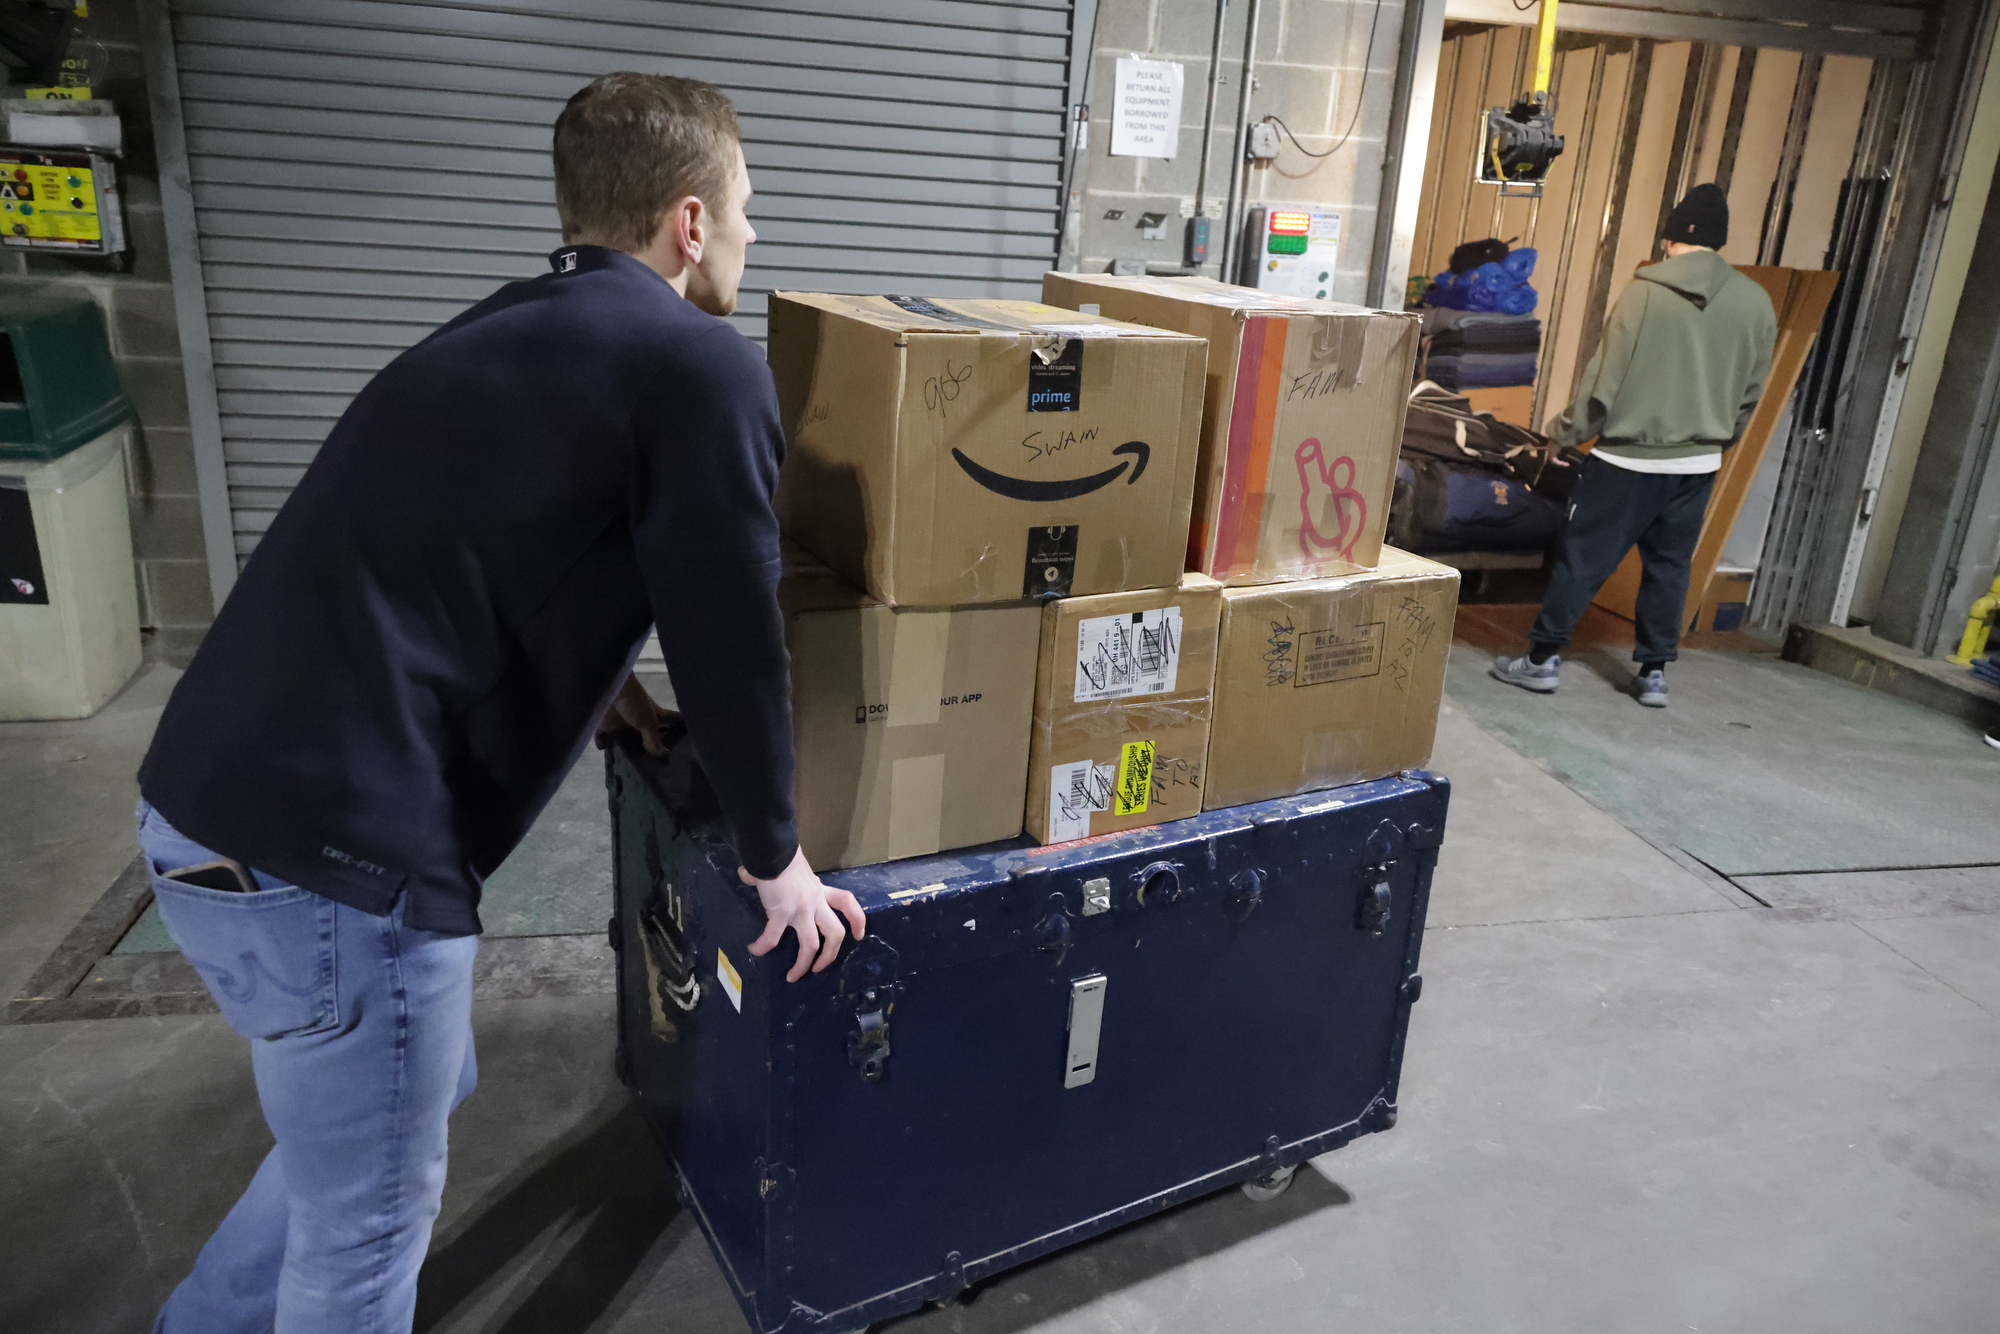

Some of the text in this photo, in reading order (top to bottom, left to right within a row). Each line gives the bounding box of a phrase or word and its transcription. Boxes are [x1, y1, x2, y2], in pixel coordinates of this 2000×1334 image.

[1136, 71, 1163, 79] PLEASE
[1126, 83, 1171, 94] RETURN ALL
[1125, 96, 1170, 106] EQUIPMENT
[1124, 109, 1169, 119] BORROWED
[1125, 122, 1165, 131] FROM THIS
[1134, 135, 1154, 143] AREA
[1287, 369, 1345, 402] FAM
[1031, 389, 1071, 406] prime
[1022, 427, 1099, 462] SWAIN
[961, 693, 982, 704] APP
[1173, 758, 1188, 785] TO
[1151, 755, 1170, 806] FAM
[1030, 836, 1101, 856] COLLARED
